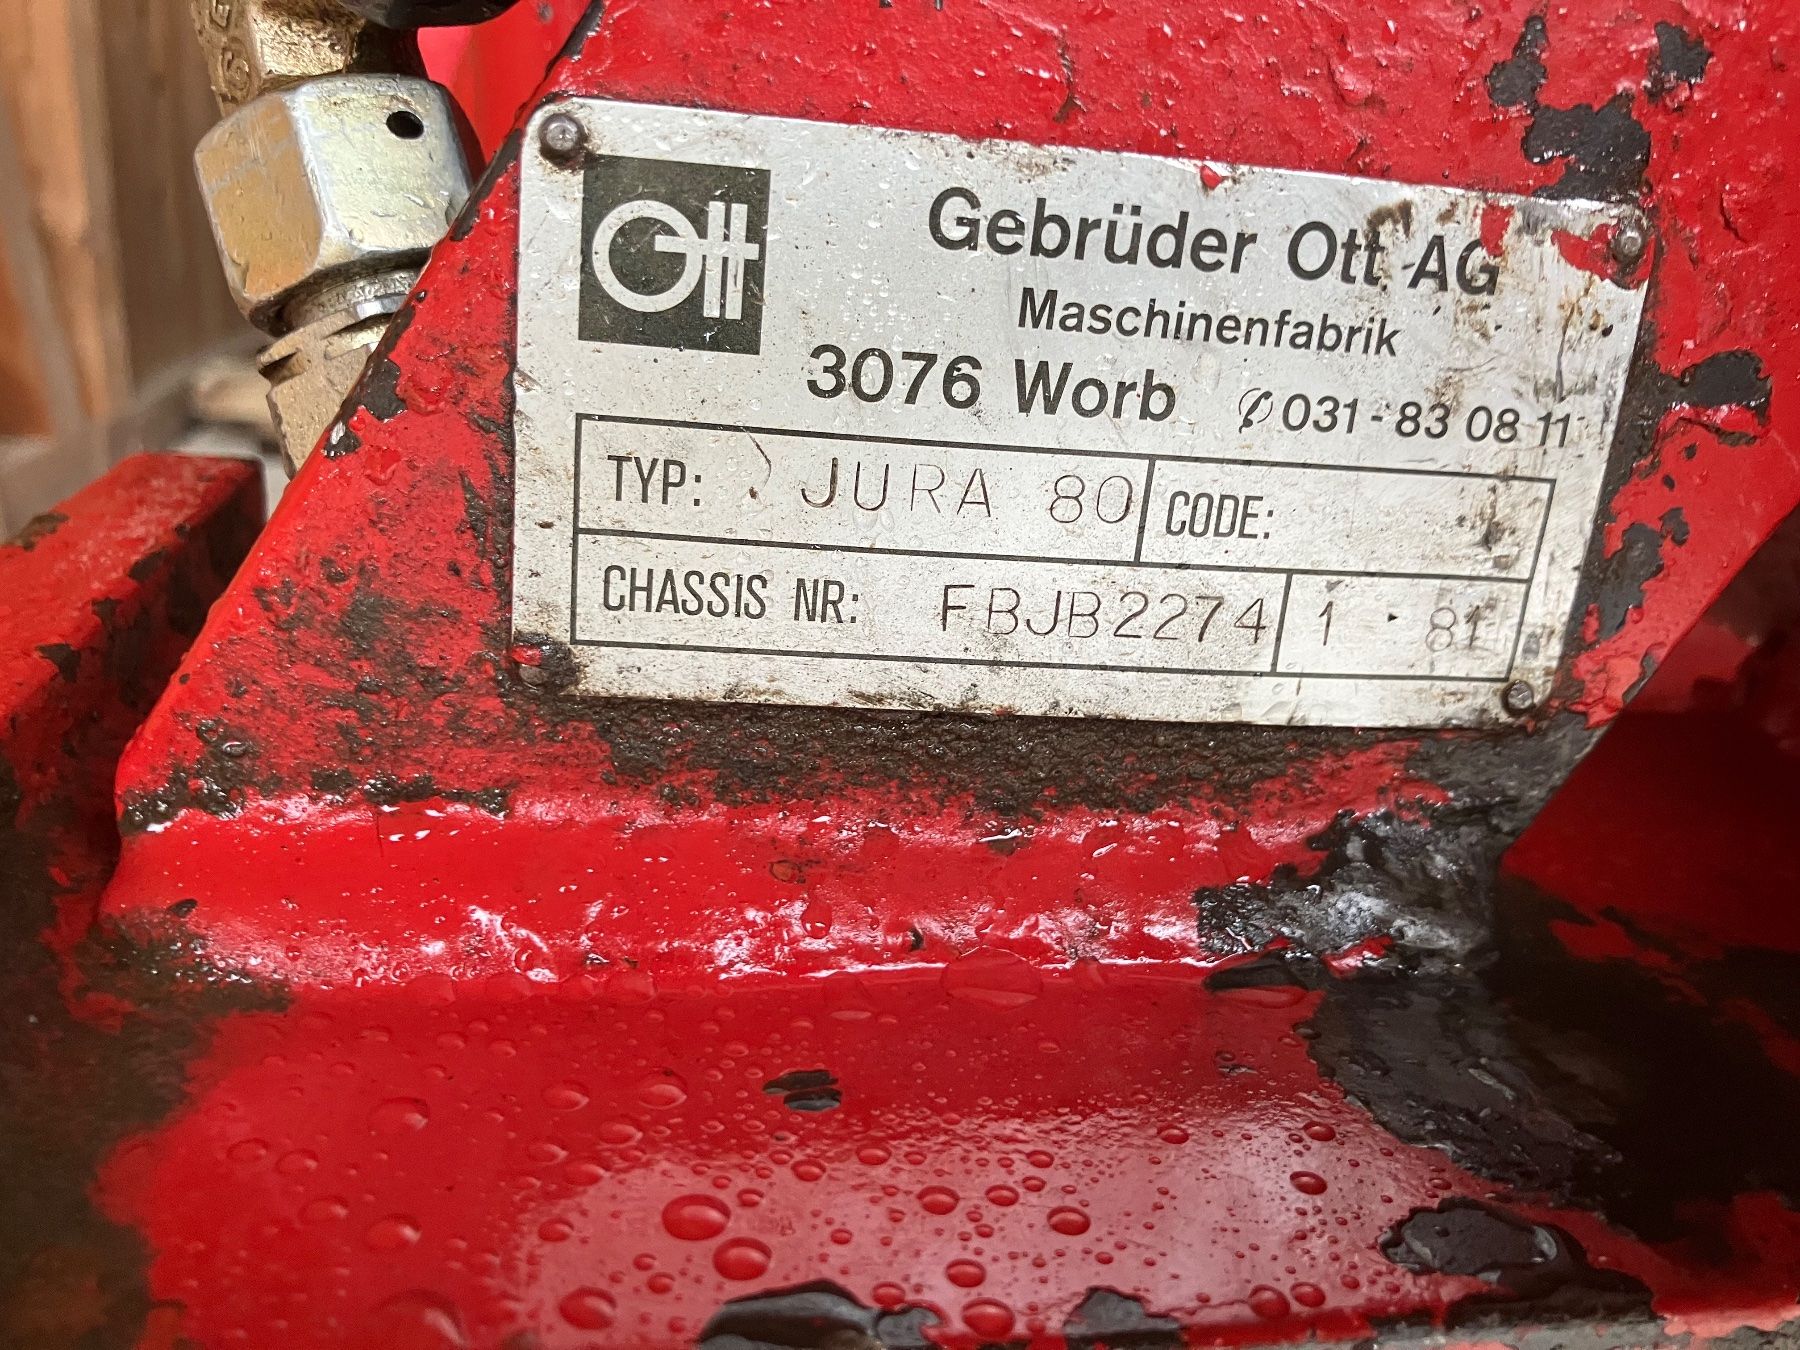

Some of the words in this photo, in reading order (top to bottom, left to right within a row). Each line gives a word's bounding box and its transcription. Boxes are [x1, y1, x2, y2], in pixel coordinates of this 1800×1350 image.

[927, 186, 1257, 275] Gebrüder
[1286, 220, 1383, 287] Ott
[1406, 234, 1500, 296] AG
[1017, 286, 1401, 358] Maschinenfabrik
[806, 344, 983, 409] 3076
[1013, 359, 1176, 422] Worb
[1281, 394, 1356, 435] 031
[1395, 401, 1451, 439] 83
[1465, 405, 1520, 444] 08
[1537, 411, 1571, 448] 11
[606, 454, 703, 507] TYP:
[800, 457, 992, 518] JURA
[1049, 473, 1135, 525] 80
[1164, 490, 1274, 540] CODE:
[602, 564, 768, 620] CHASSIS
[794, 577, 859, 624] NR:
[941, 584, 1268, 645] FBJB2274
[1318, 600, 1334, 647] 1
[1425, 604, 1481, 652] 81
